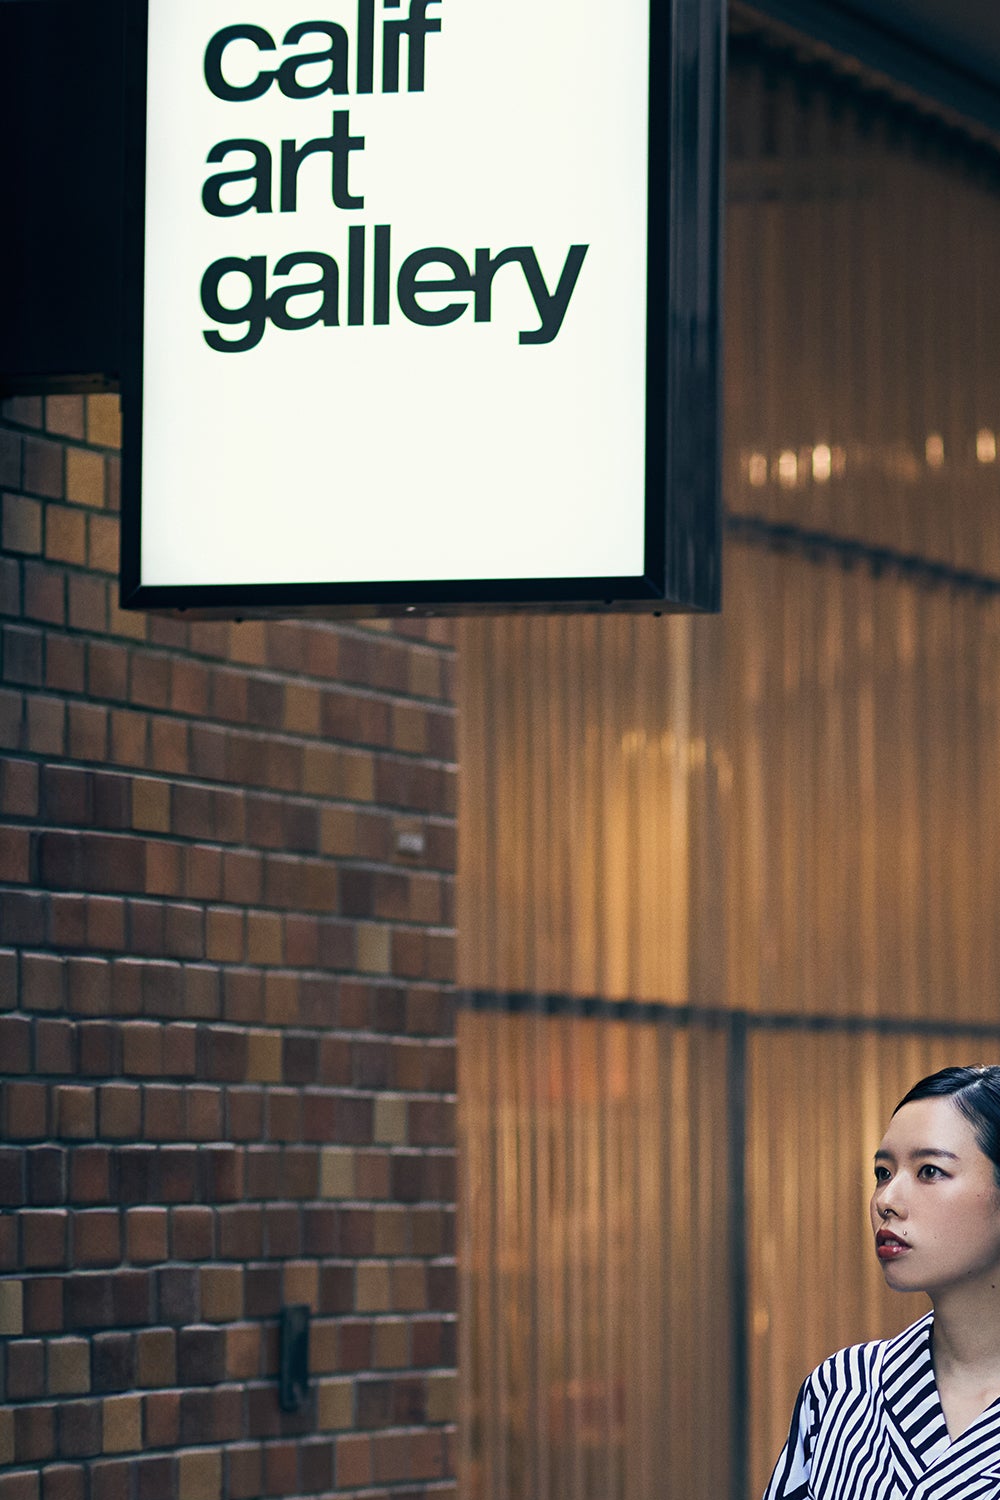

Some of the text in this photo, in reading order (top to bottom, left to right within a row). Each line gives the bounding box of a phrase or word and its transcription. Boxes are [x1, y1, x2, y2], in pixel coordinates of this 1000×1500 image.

[203, 0, 443, 102] calif
[201, 109, 365, 218] art
[200, 224, 590, 353] gallery
